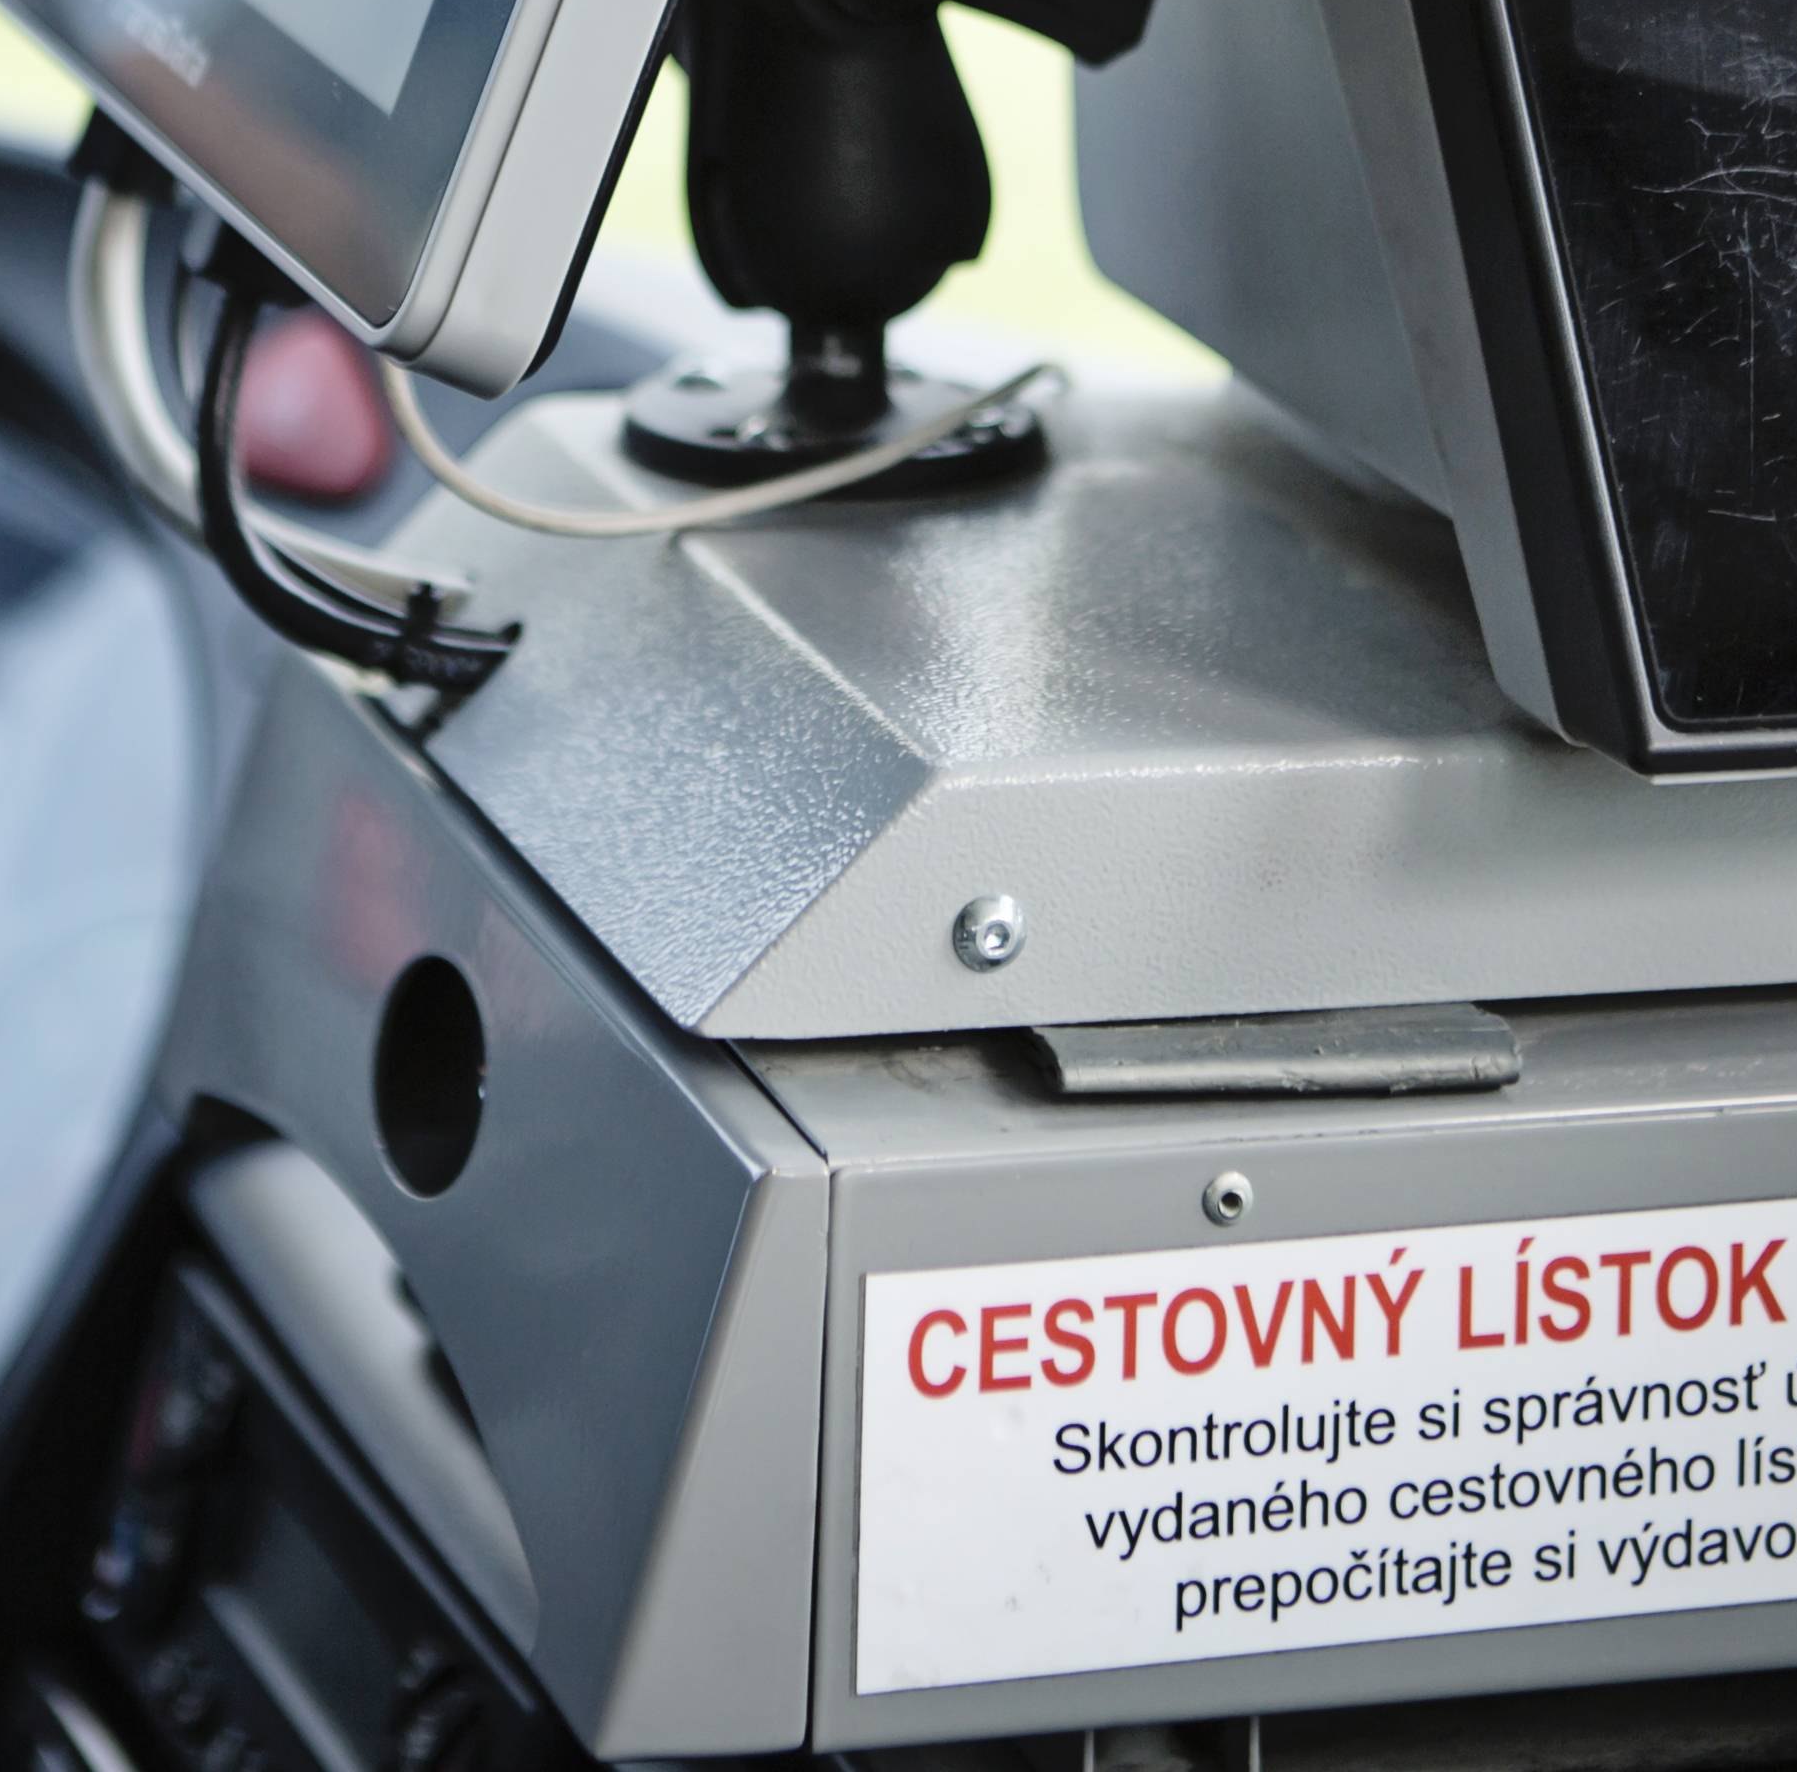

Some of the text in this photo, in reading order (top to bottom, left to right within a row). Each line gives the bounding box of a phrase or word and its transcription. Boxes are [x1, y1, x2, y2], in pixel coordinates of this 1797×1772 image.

[909, 1247, 1423, 1397] CESTOVNÝ
[1459, 1238, 1786, 1349] LÍSTOK
[1054, 1400, 1395, 1474] Skontrolujte
[1419, 1389, 1459, 1440] si
[1484, 1361, 1766, 1447] správnosť
[1085, 1479, 1368, 1561] vydaného
[1390, 1446, 1715, 1519] cestovného
[1176, 1541, 1512, 1632] prepočítajte
[1534, 1530, 1575, 1582] si
